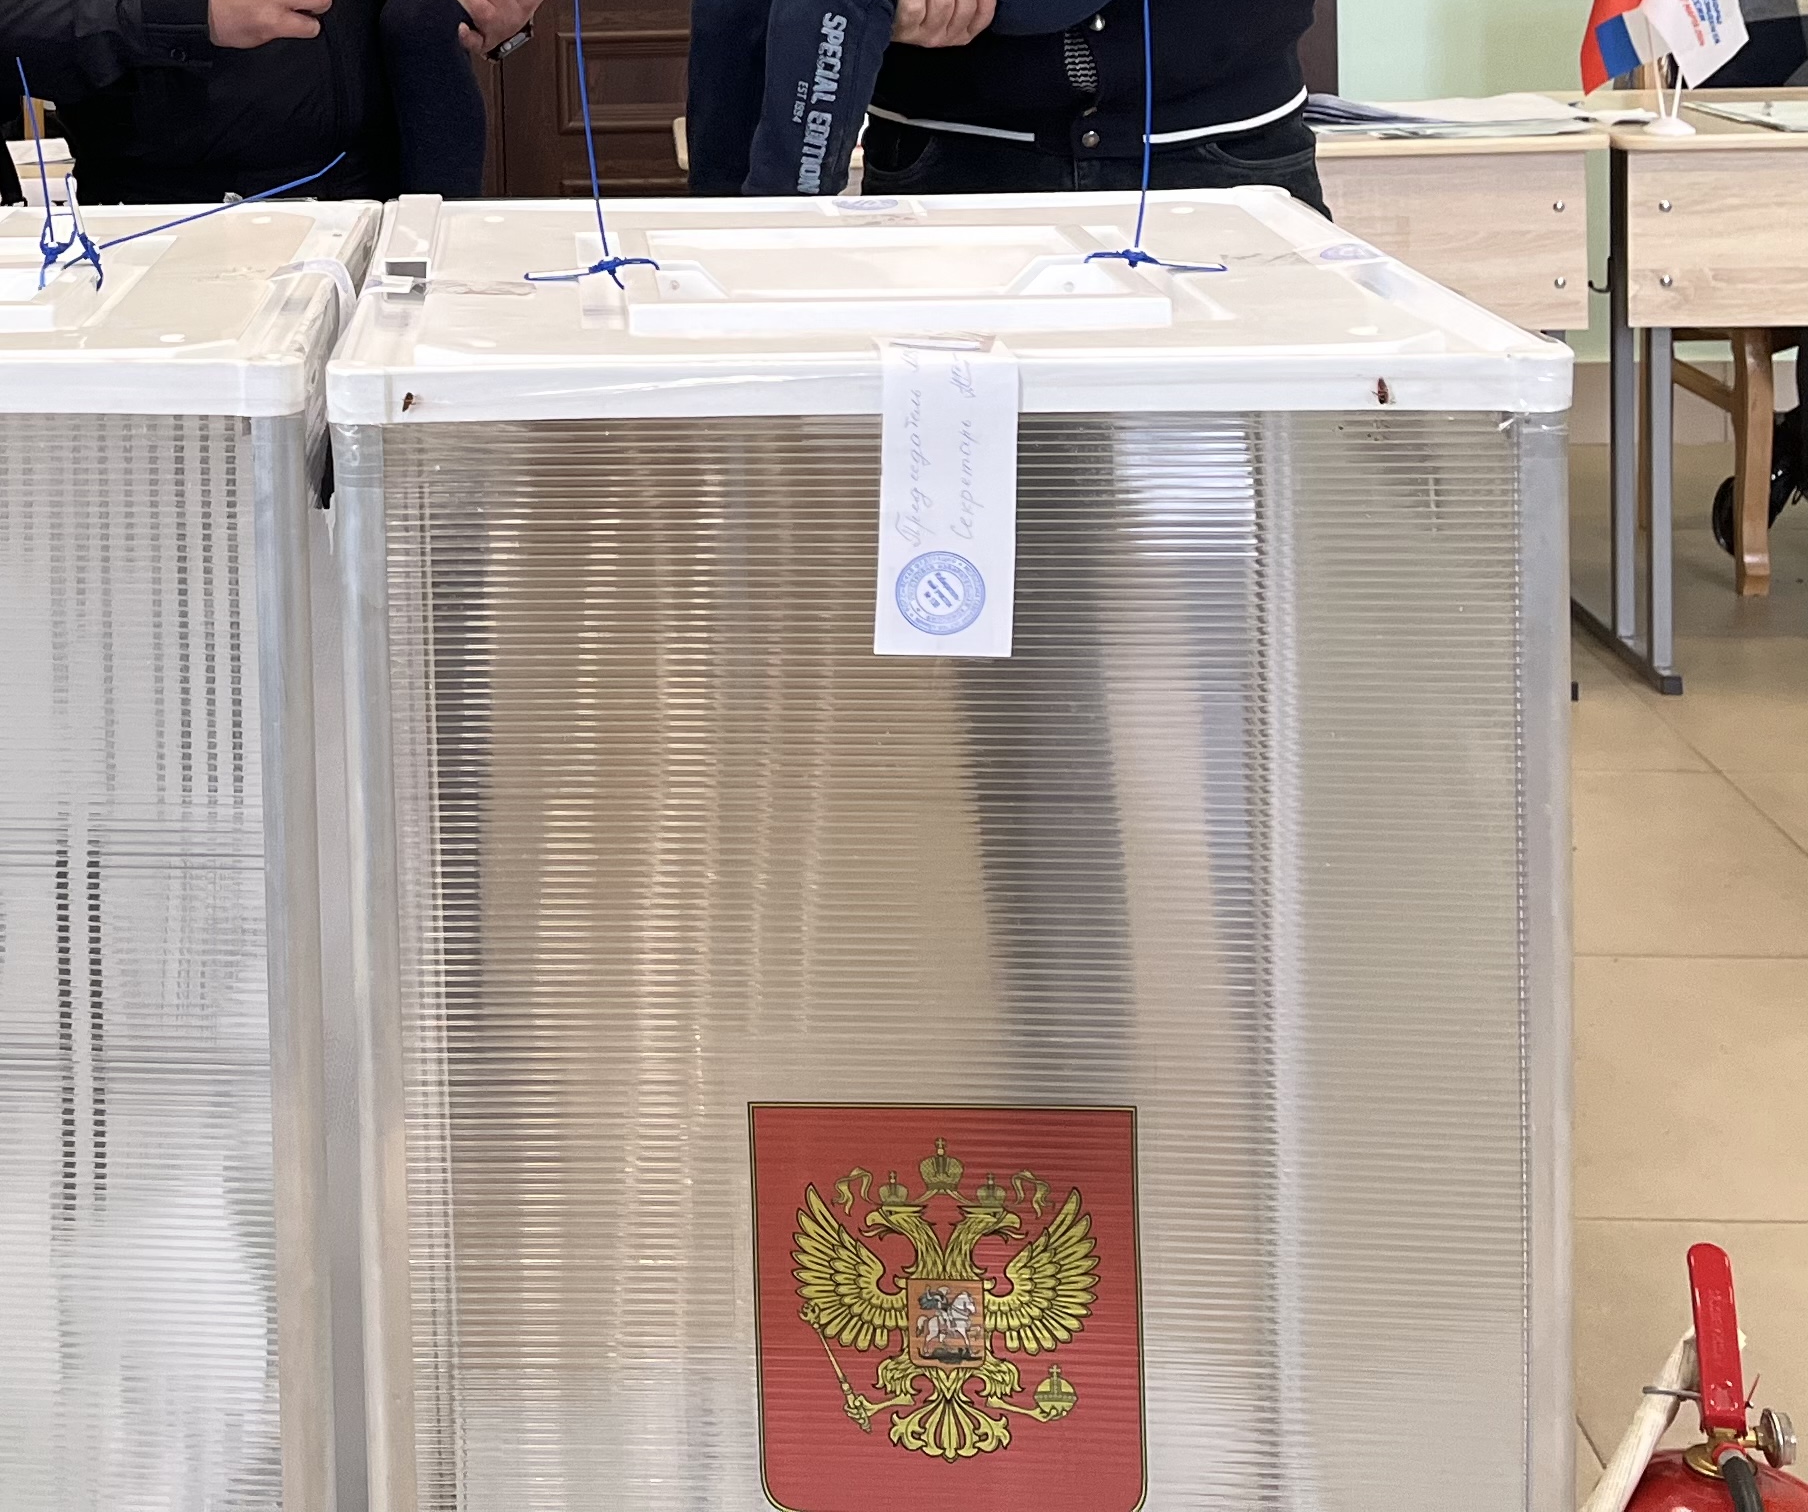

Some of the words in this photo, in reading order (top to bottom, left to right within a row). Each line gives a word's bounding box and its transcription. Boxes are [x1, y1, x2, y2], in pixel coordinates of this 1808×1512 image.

[796, 80, 809, 100] EST
[810, 12, 848, 105] SPECIAL
[797, 110, 833, 194] EDITION
